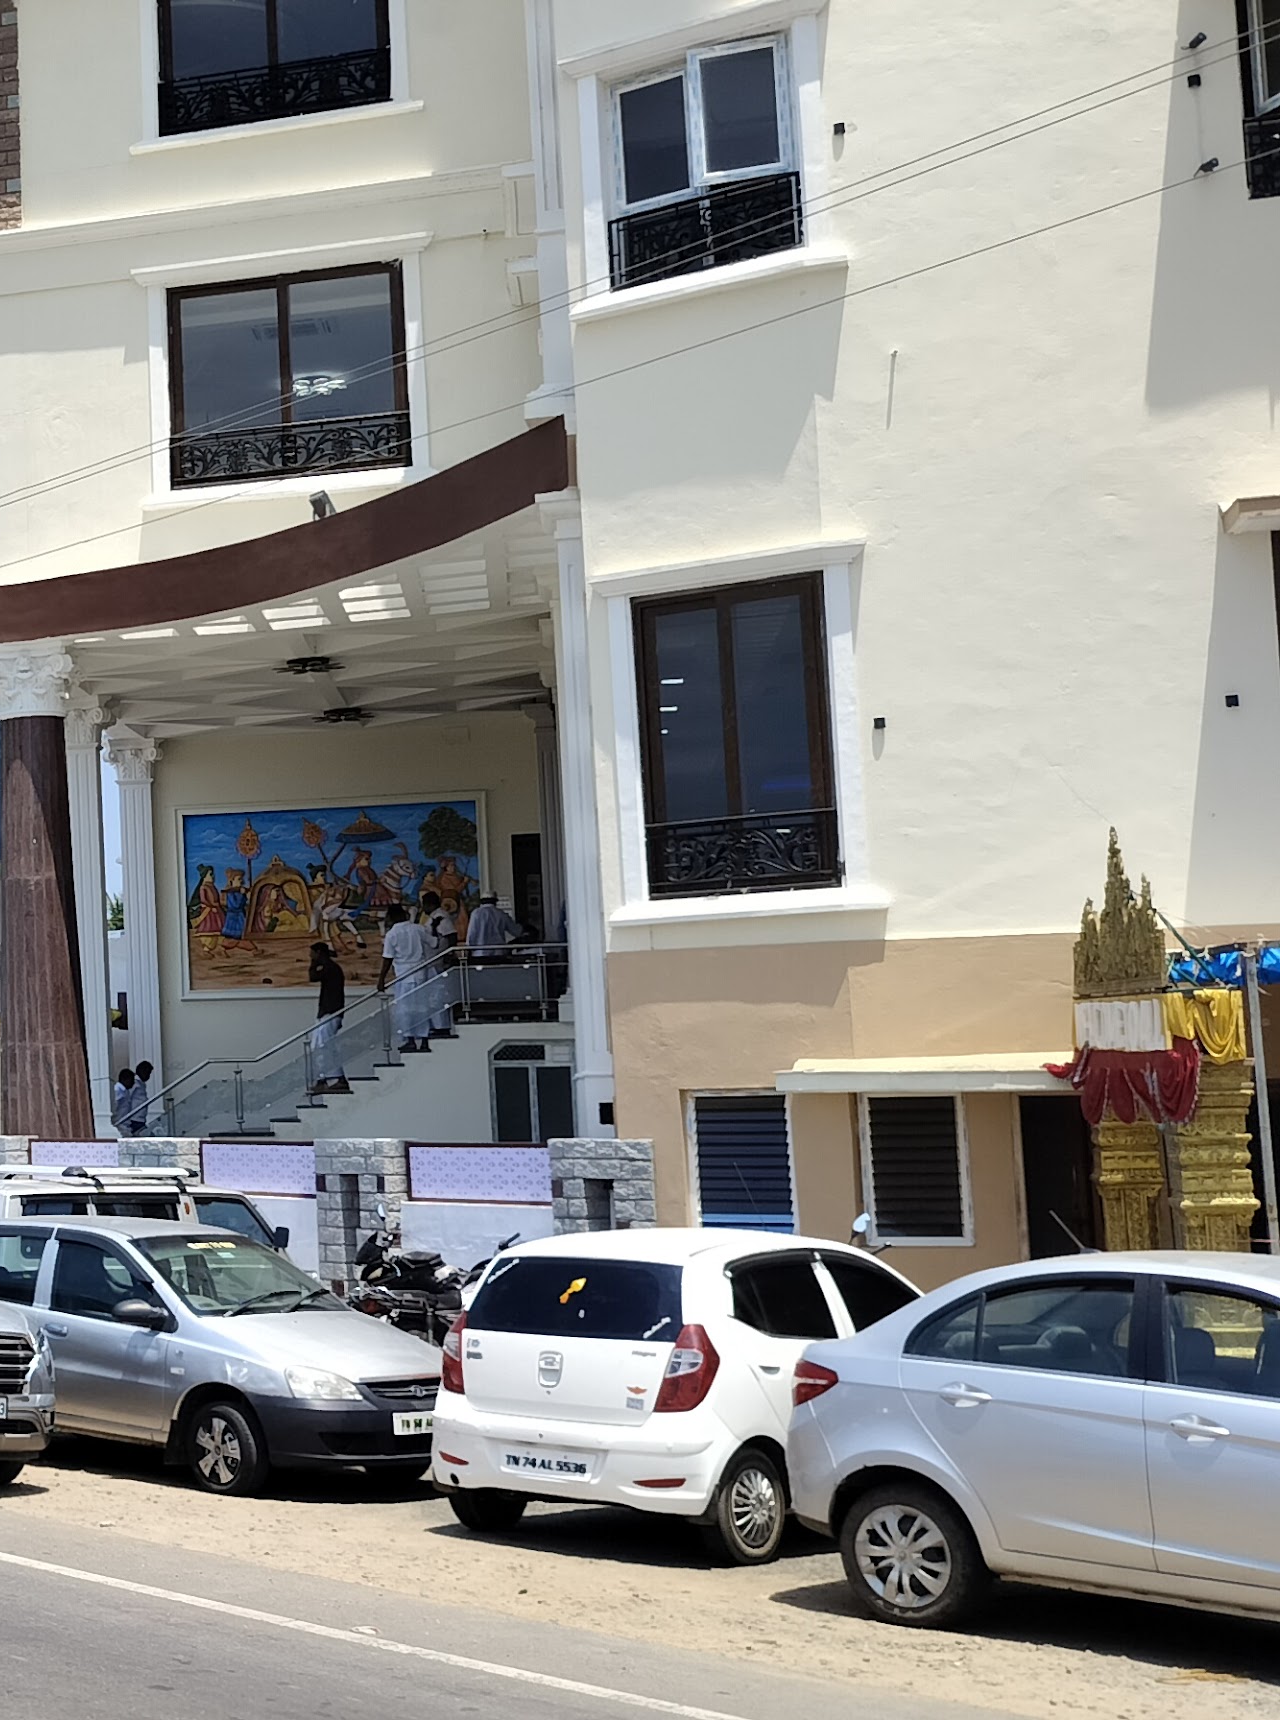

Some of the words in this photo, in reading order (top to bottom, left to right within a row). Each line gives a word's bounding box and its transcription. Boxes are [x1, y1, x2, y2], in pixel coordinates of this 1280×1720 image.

[506, 1454, 520, 1466] TN
[522, 1456, 537, 1469] 74
[538, 1458, 554, 1471] AL
